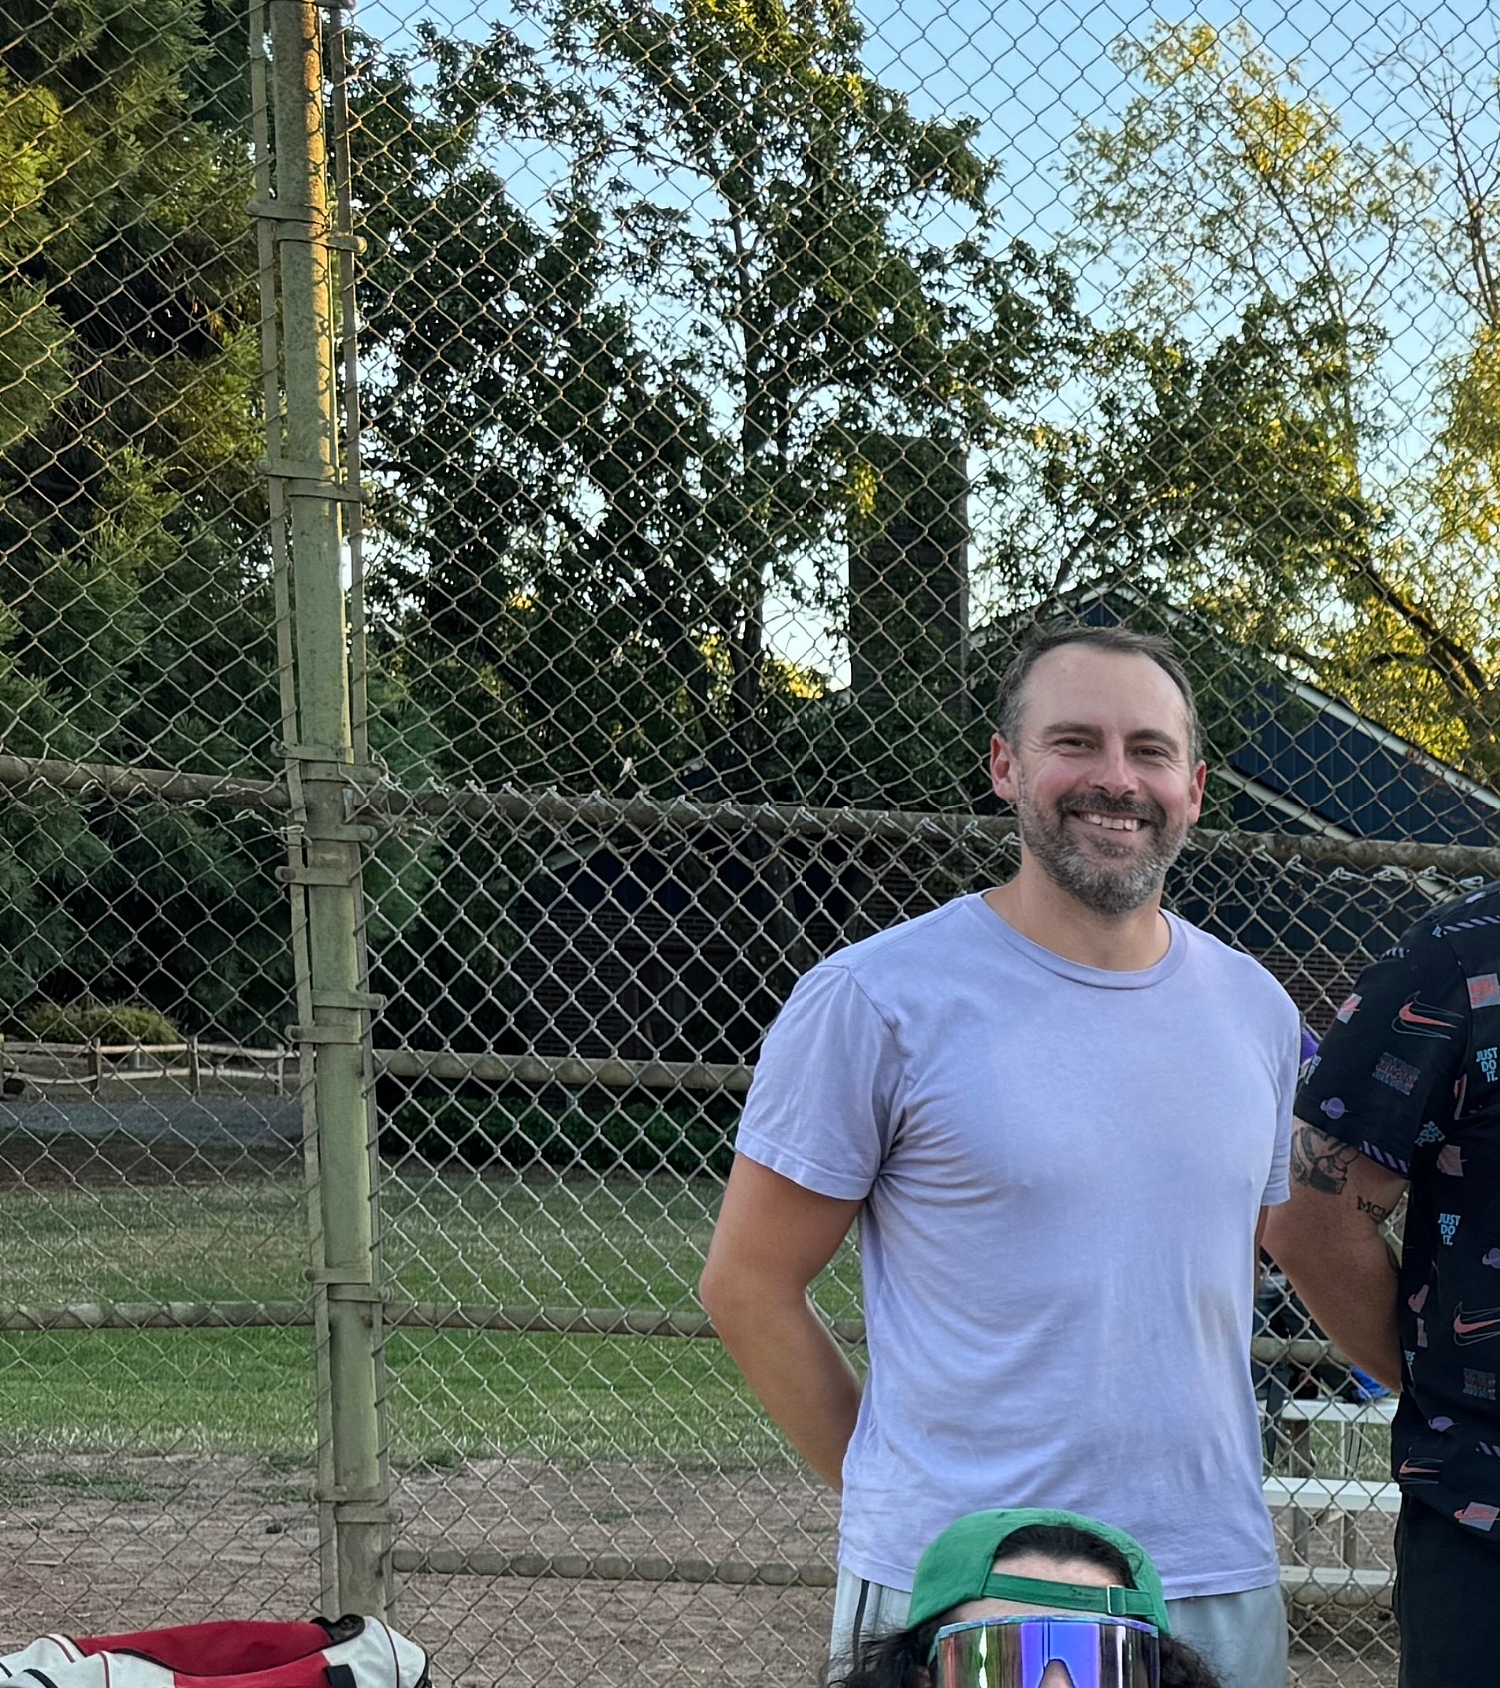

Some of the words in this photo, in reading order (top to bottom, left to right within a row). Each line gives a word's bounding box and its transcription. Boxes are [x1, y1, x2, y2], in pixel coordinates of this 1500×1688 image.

[1475, 1047, 1498, 1062] JUST
[1480, 1060, 1497, 1072] DO
[1437, 1212, 1461, 1226] JUST
[1440, 1224, 1456, 1235] DO
